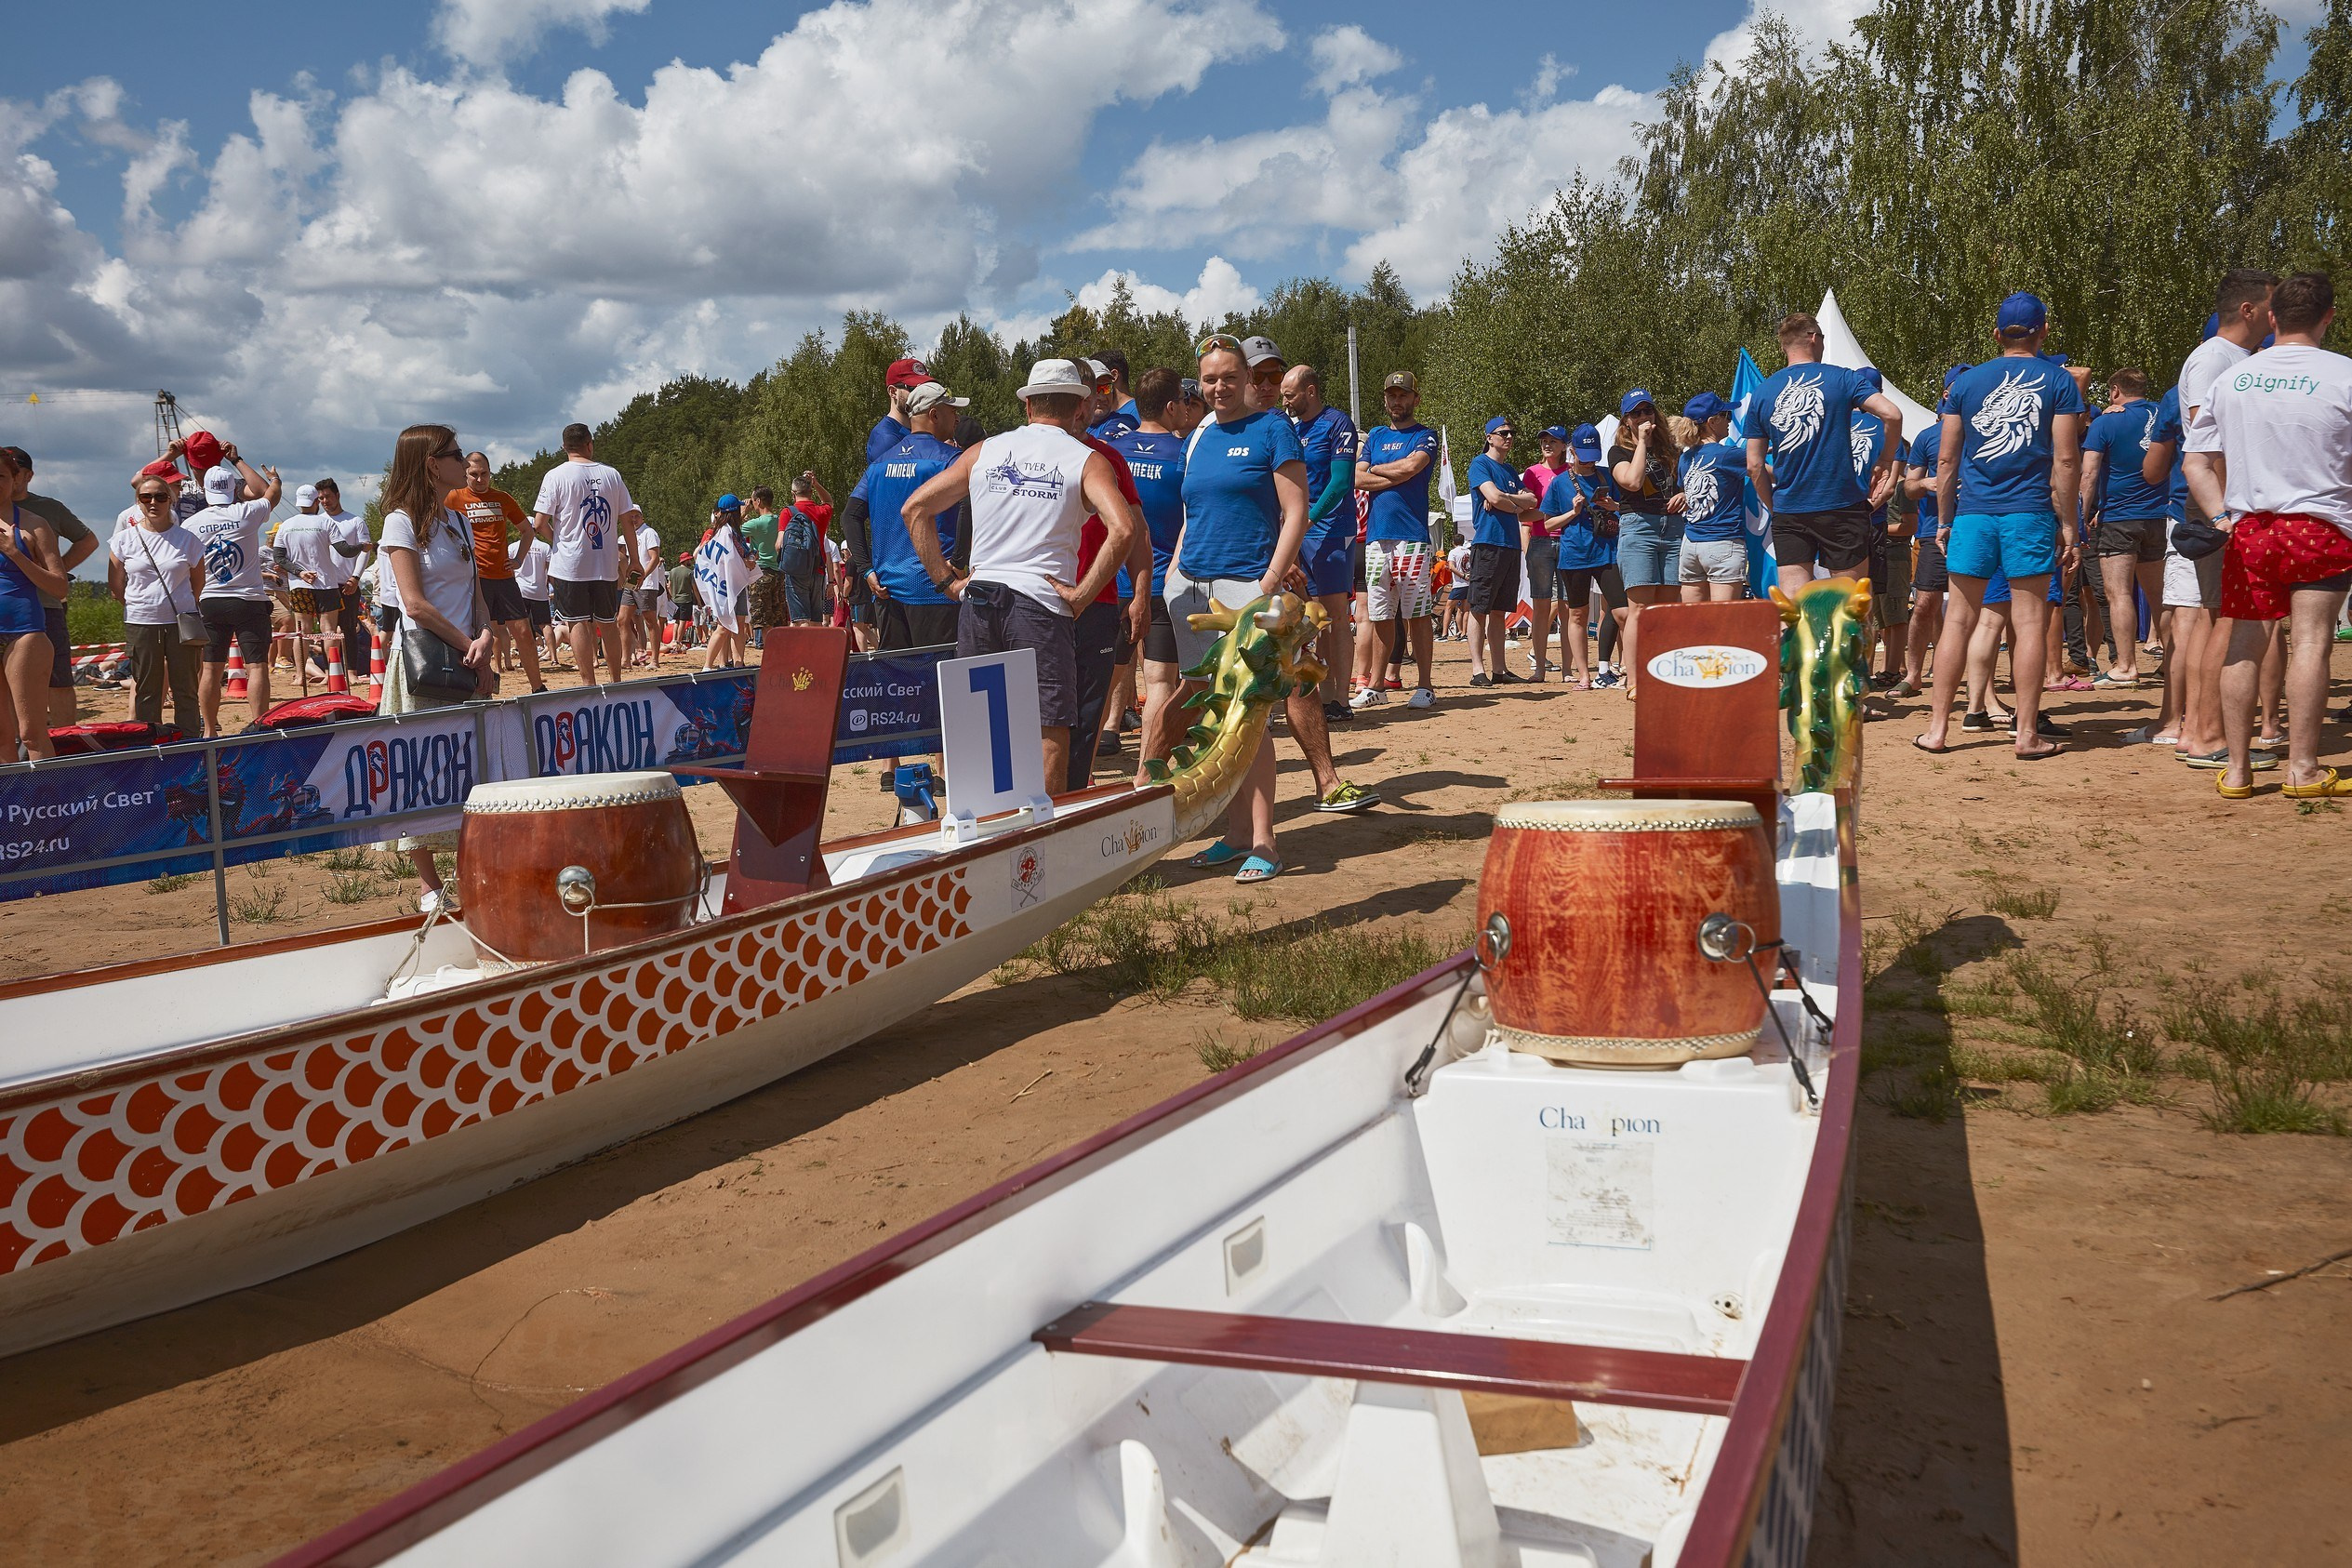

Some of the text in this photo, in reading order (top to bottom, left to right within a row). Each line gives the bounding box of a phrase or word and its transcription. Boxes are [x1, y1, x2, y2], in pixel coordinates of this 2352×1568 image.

[1227, 446, 1250, 457] SDS
[885, 462, 918, 479] ЛИПЕЦК
[1024, 462, 1046, 472] TVER
[1127, 461, 1163, 480] ИПЕЦК
[1012, 488, 1058, 500] STORM
[464, 501, 502, 510] UNDER
[199, 520, 241, 534] СПРИНТ
[1655, 657, 1757, 680] Chapion
[843, 683, 883, 698] сский
[870, 711, 921, 725] RS24.ru
[968, 662, 1014, 794] 1
[534, 699, 657, 777] ДРАКОН
[343, 730, 474, 818] ДРАКОН
[7, 794, 98, 826] Русский
[1101, 822, 1158, 857] Chapion
[1539, 1105, 1661, 1137] Chapion
